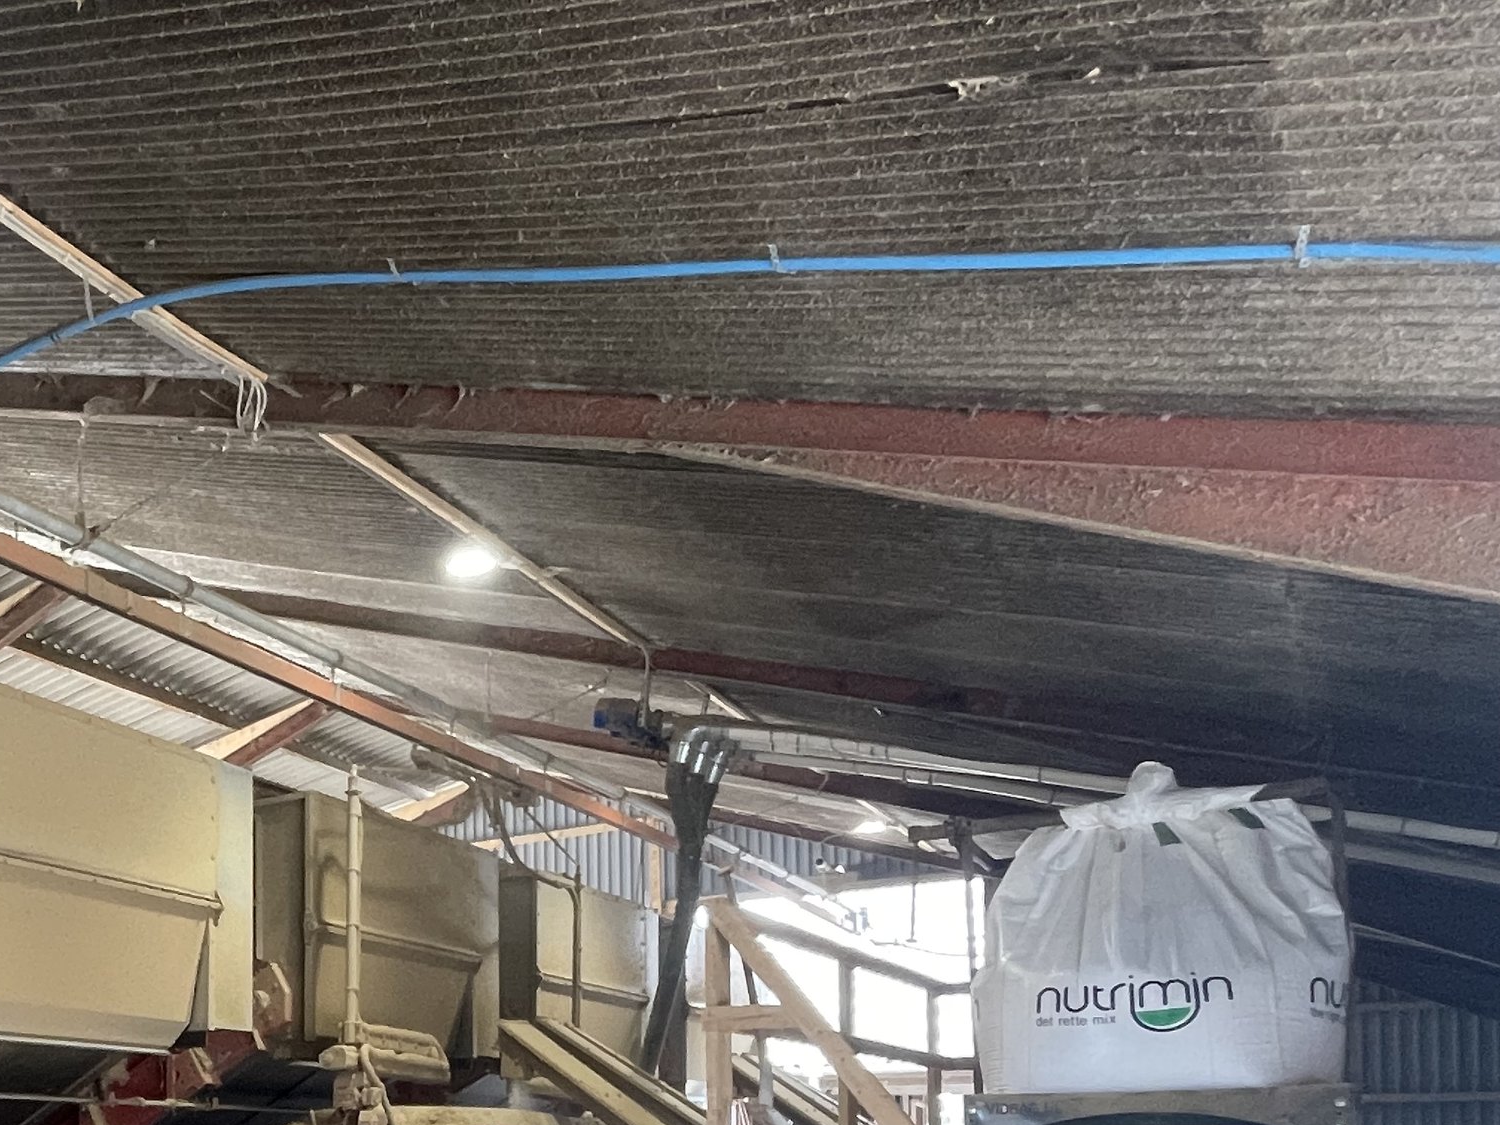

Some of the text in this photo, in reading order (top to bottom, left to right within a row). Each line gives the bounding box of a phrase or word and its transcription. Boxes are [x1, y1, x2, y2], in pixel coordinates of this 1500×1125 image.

[1036, 972, 1234, 1031] nutrimin
[1058, 1016, 1088, 1027] rette
[1092, 1014, 1117, 1025] mix
